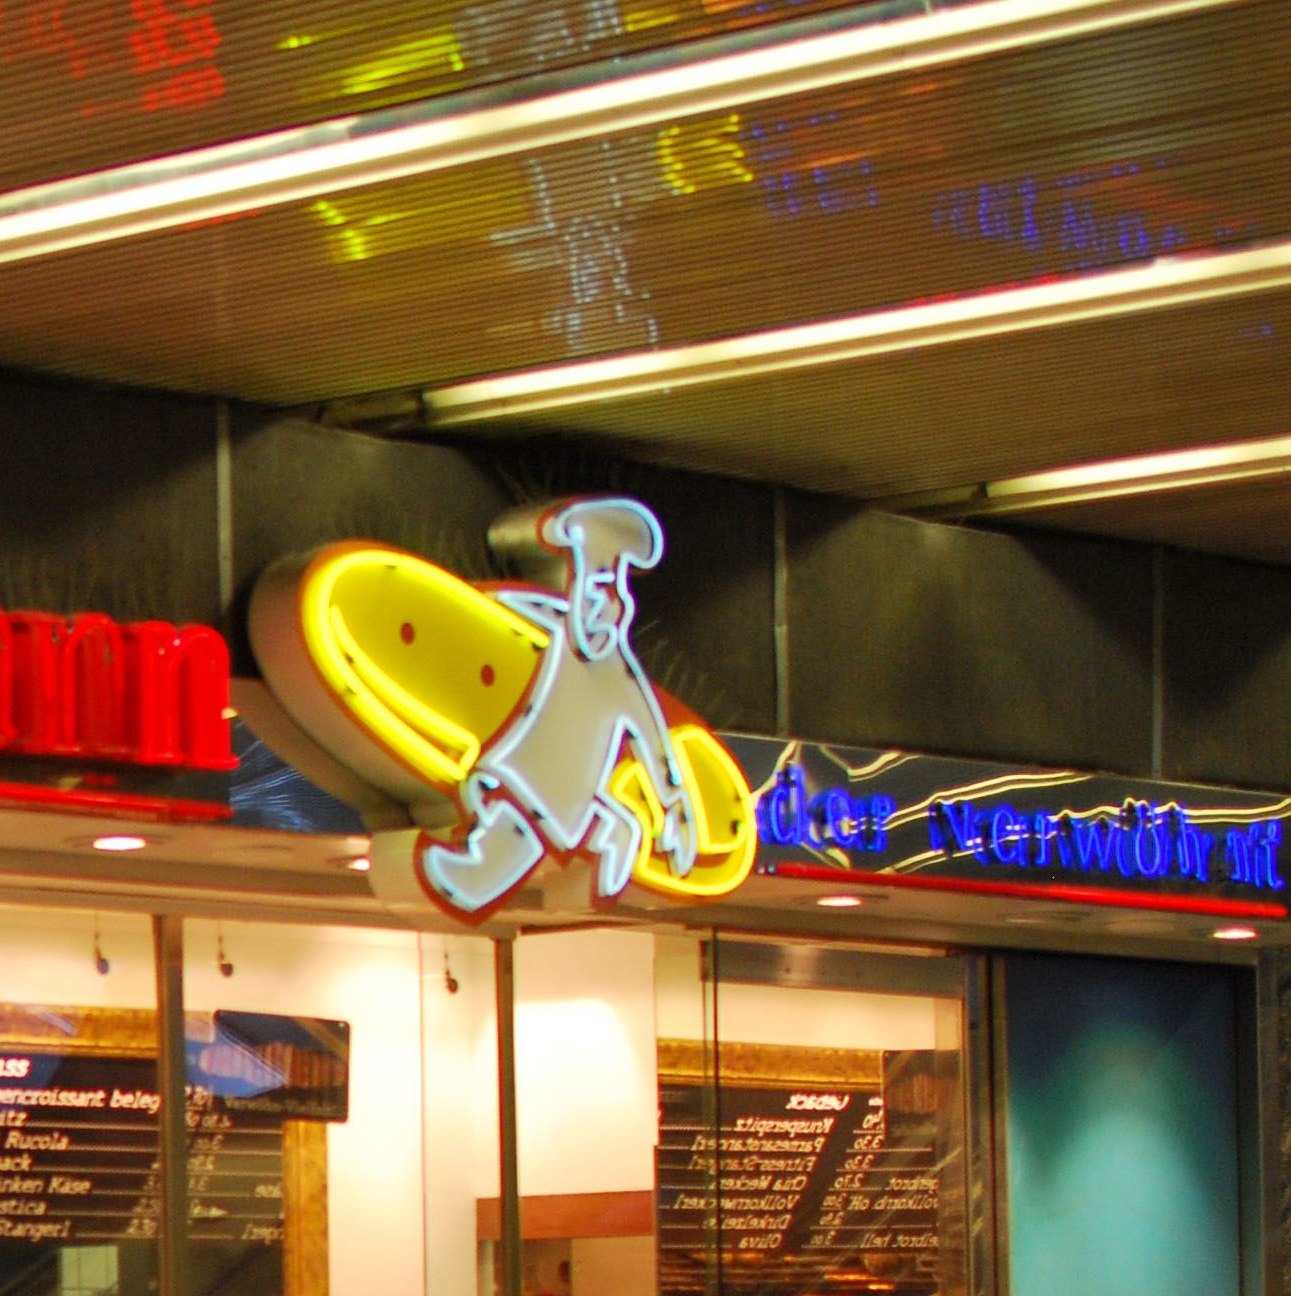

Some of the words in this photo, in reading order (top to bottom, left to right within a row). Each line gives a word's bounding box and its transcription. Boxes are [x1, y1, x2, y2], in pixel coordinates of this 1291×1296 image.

[757, 762, 897, 850] der
[927, 797, 1287, 889] verwöhnt
[109, 1088, 163, 1115] beleg
[4, 1130, 70, 1151] Rucola
